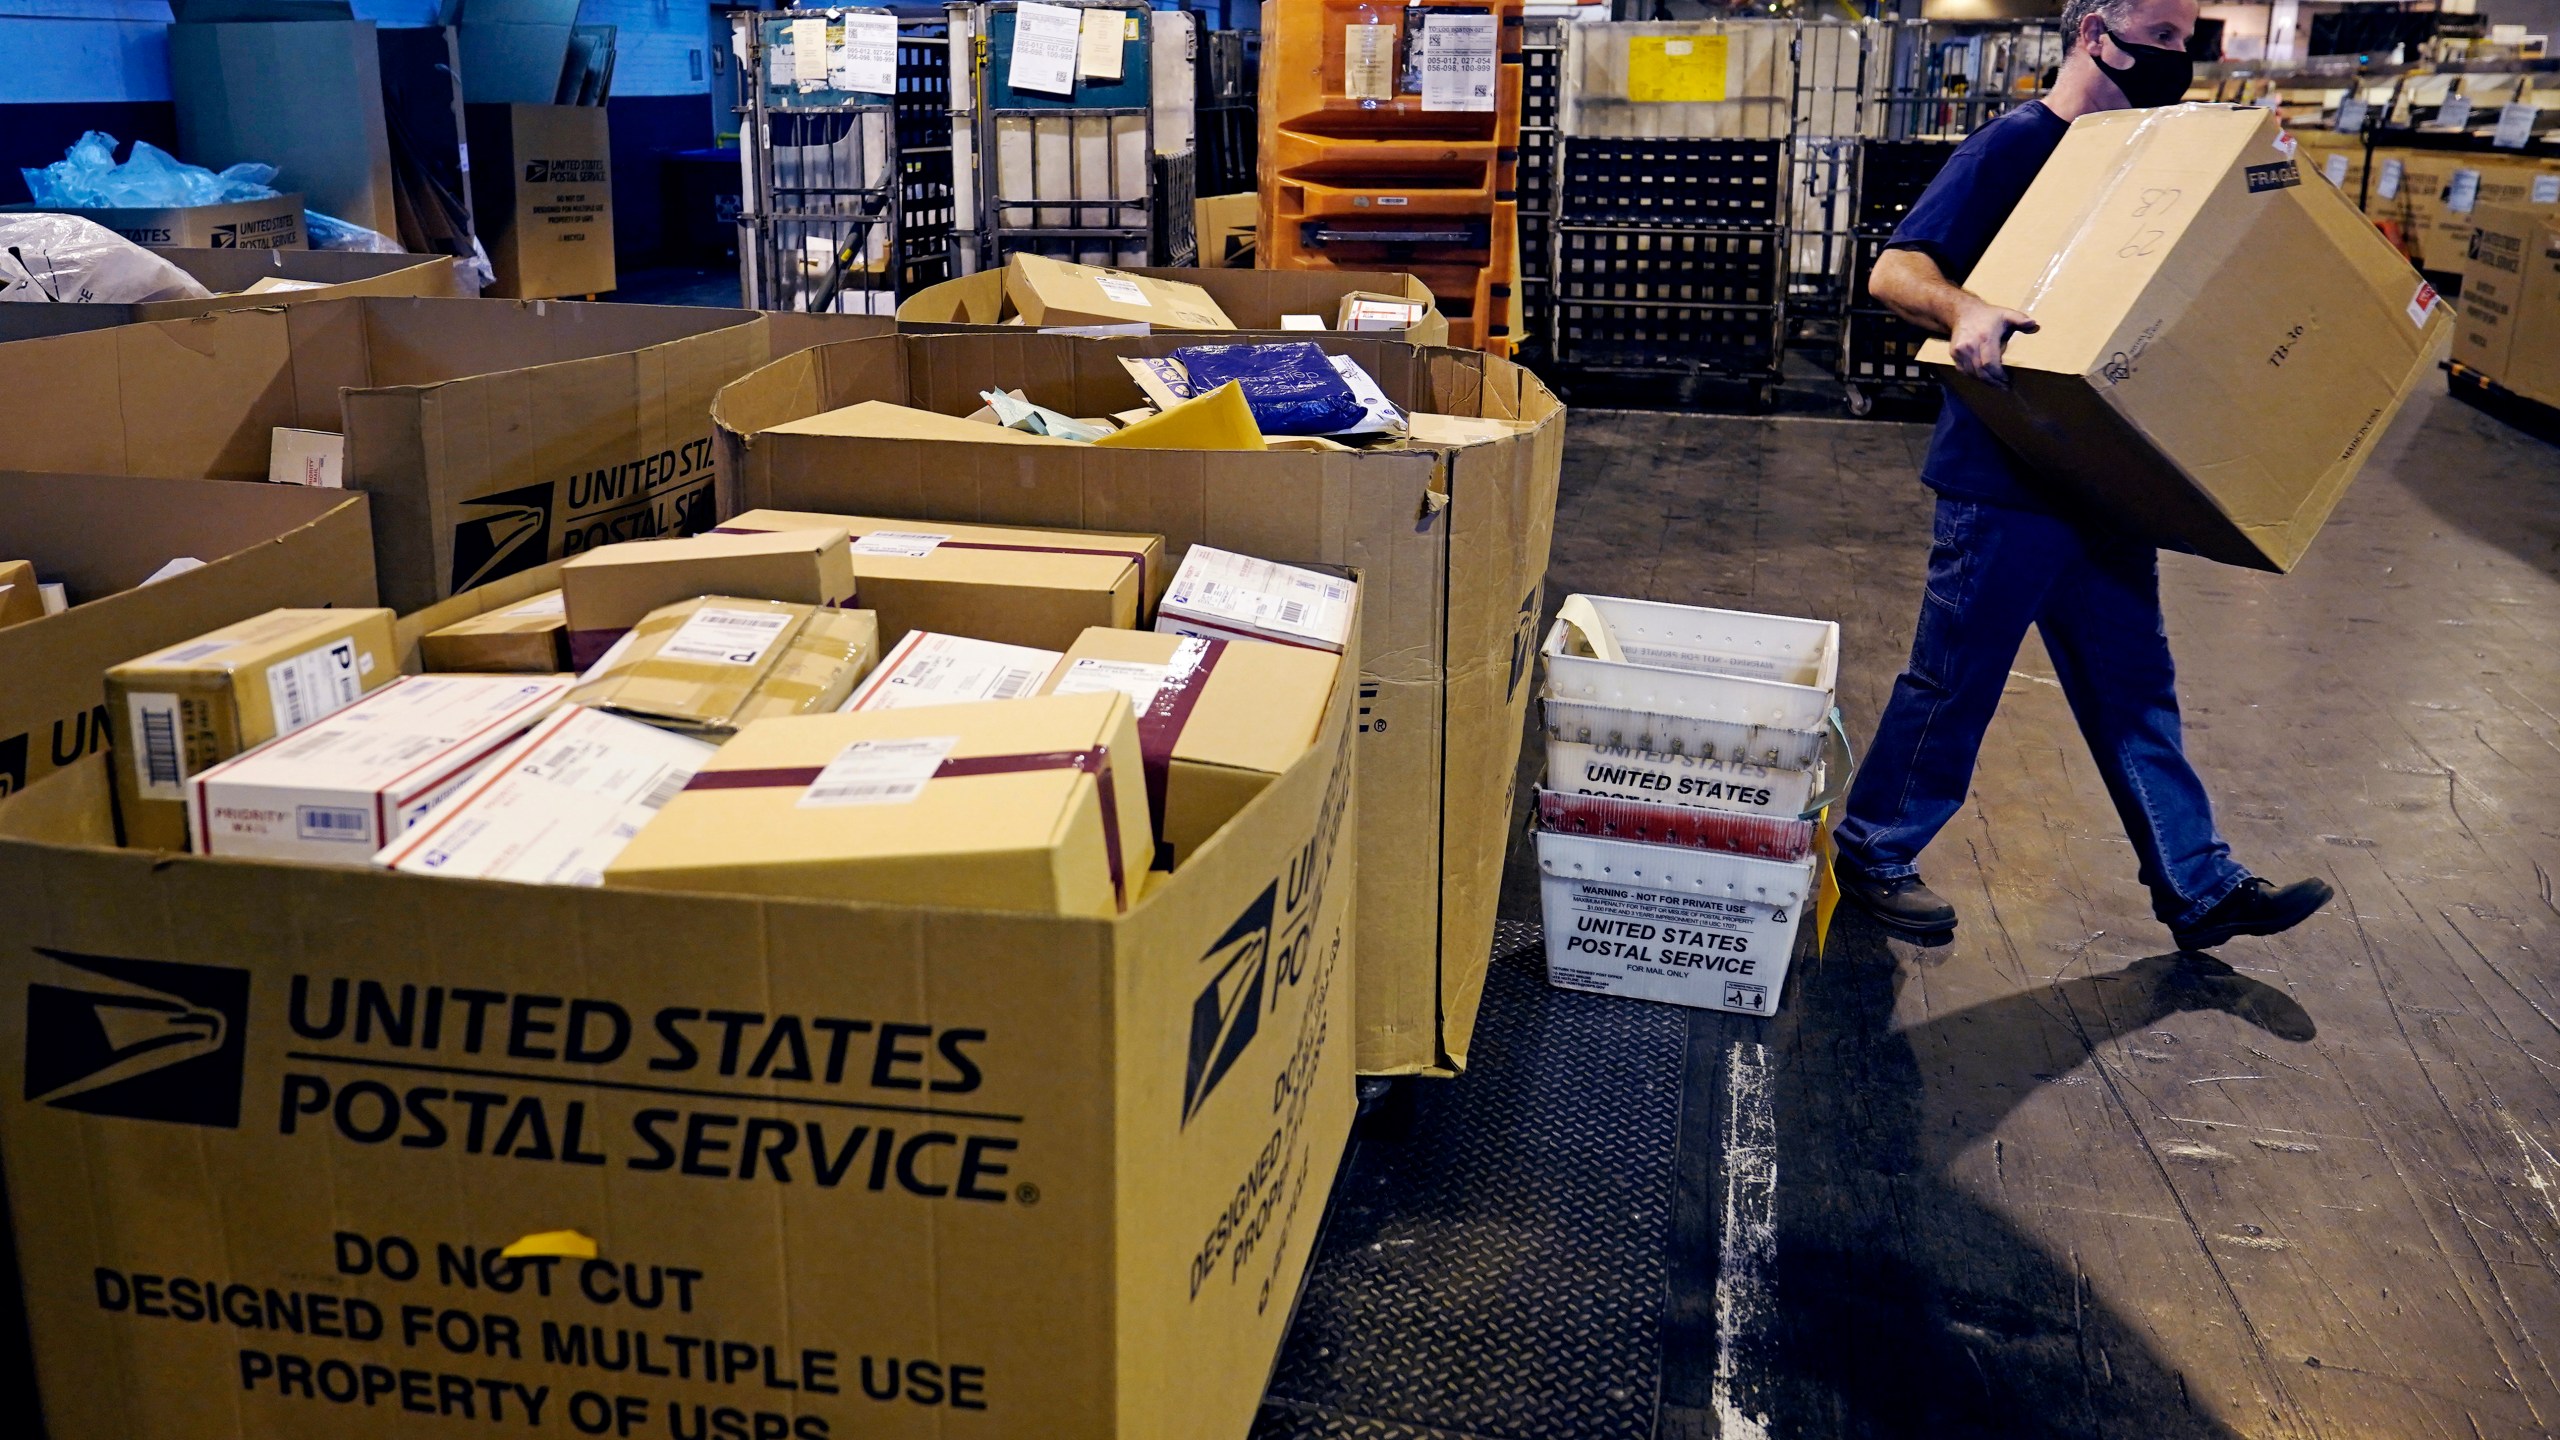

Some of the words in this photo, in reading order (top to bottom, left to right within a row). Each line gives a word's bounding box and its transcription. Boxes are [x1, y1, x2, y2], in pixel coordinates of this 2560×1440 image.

[1427, 64, 1459, 72] 056-098,
[1461, 64, 1491, 72] 100-999
[240, 219, 272, 234] UNITED
[272, 214, 295, 230] STATES
[568, 450, 676, 510] UNITED
[562, 502, 668, 557] POSTAL
[331, 645, 350, 668] P
[1586, 765, 1672, 791] UNITED
[1678, 778, 1771, 806] STATES
[213, 807, 286, 822] PRIORITY
[232, 824, 268, 835] MAIL
[1572, 896, 1600, 904] MAXIMUM
[1600, 900, 1626, 908] PENALTY
[1668, 908, 1689, 916] MISUSE
[1700, 912, 1720, 920] POSTAL
[1722, 916, 1754, 924] PROPERTY
[1582, 885, 1628, 898] WARNING
[1636, 892, 1657, 902] NOT
[1660, 895, 1680, 905] FOR
[1682, 898, 1724, 910] PRIVATE
[1726, 904, 1746, 914] USE
[1604, 906, 1617, 914] FINE
[1636, 910, 1654, 918] YEARS
[1656, 914, 1698, 924] IMPRISONMENT
[1577, 916, 1656, 941] UNITED
[1662, 926, 1748, 952] STATES
[1567, 936, 1652, 962] POSTAL
[1658, 948, 1756, 976] SERVICE
[1626, 964, 1644, 972] FOR
[1646, 966, 1664, 975] MAIL
[1666, 968, 1690, 978] ONLY
[289, 975, 632, 1064] UNITED
[648, 1007, 986, 1094] STATES
[280, 1074, 606, 1165] POSTAL
[1190, 1127, 1282, 1304] DESIGNED
[334, 1231, 420, 1282] DO
[437, 1243, 560, 1297] NOT
[579, 1258, 704, 1314] CUT
[94, 1266, 384, 1342] DESIGNED
[402, 1304, 522, 1360] FOR
[541, 1320, 840, 1395] MULTIPLE
[861, 1356, 988, 1411] USE
[240, 1348, 549, 1427] PROPERTY
[568, 1390, 648, 1438] OF
